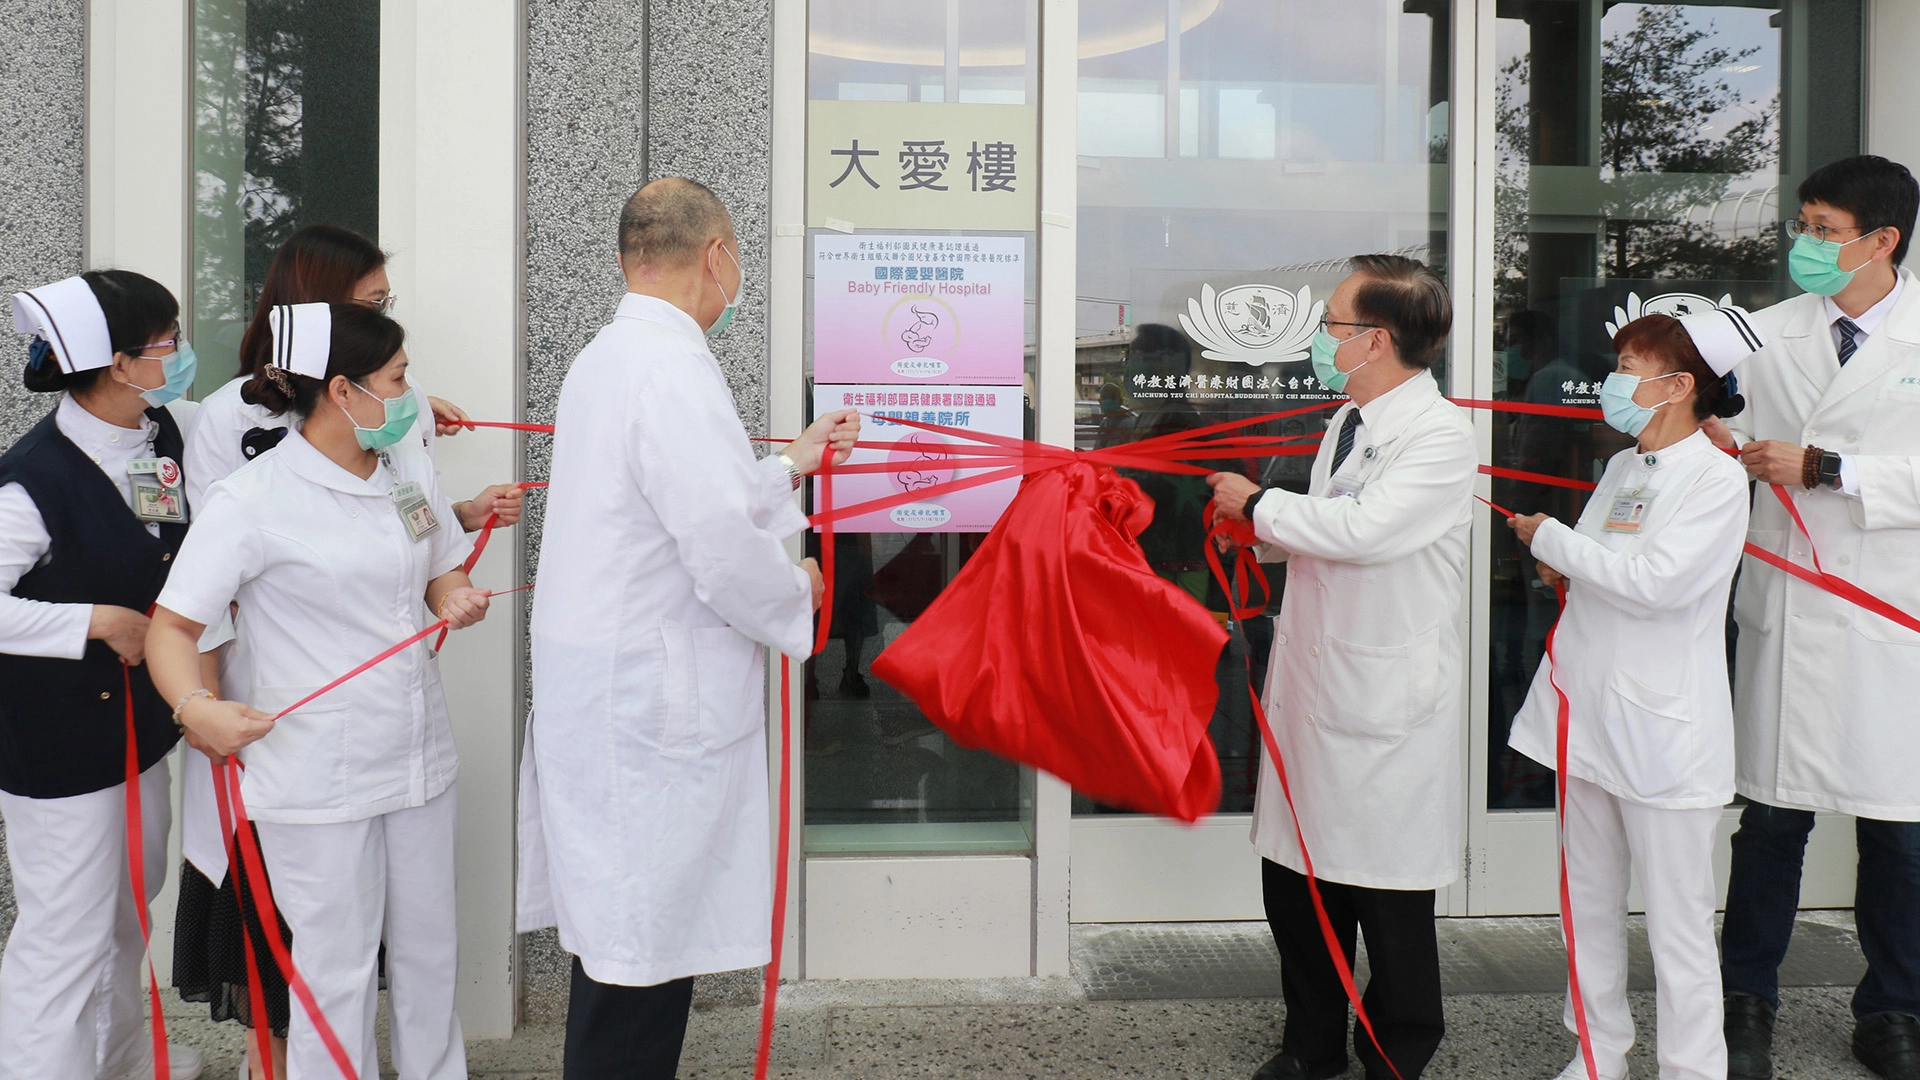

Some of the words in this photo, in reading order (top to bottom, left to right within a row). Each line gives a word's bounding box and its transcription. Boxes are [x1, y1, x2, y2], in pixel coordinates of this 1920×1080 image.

[829, 139, 1018, 193] 大愛樓
[858, 241, 980, 252] 衛生福利部國民健康署認證通過
[874, 266, 965, 281] 國際愛嬰醫院
[848, 281, 879, 296] Baby
[884, 282, 935, 296] Friendly
[938, 283, 991, 297] Hospital
[1224, 301, 1242, 317] 慈
[1272, 302, 1290, 317] 濟
[843, 393, 997, 407] 衛生福利部國民健康署認證通過
[872, 411, 970, 427] 母嬰親善院所
